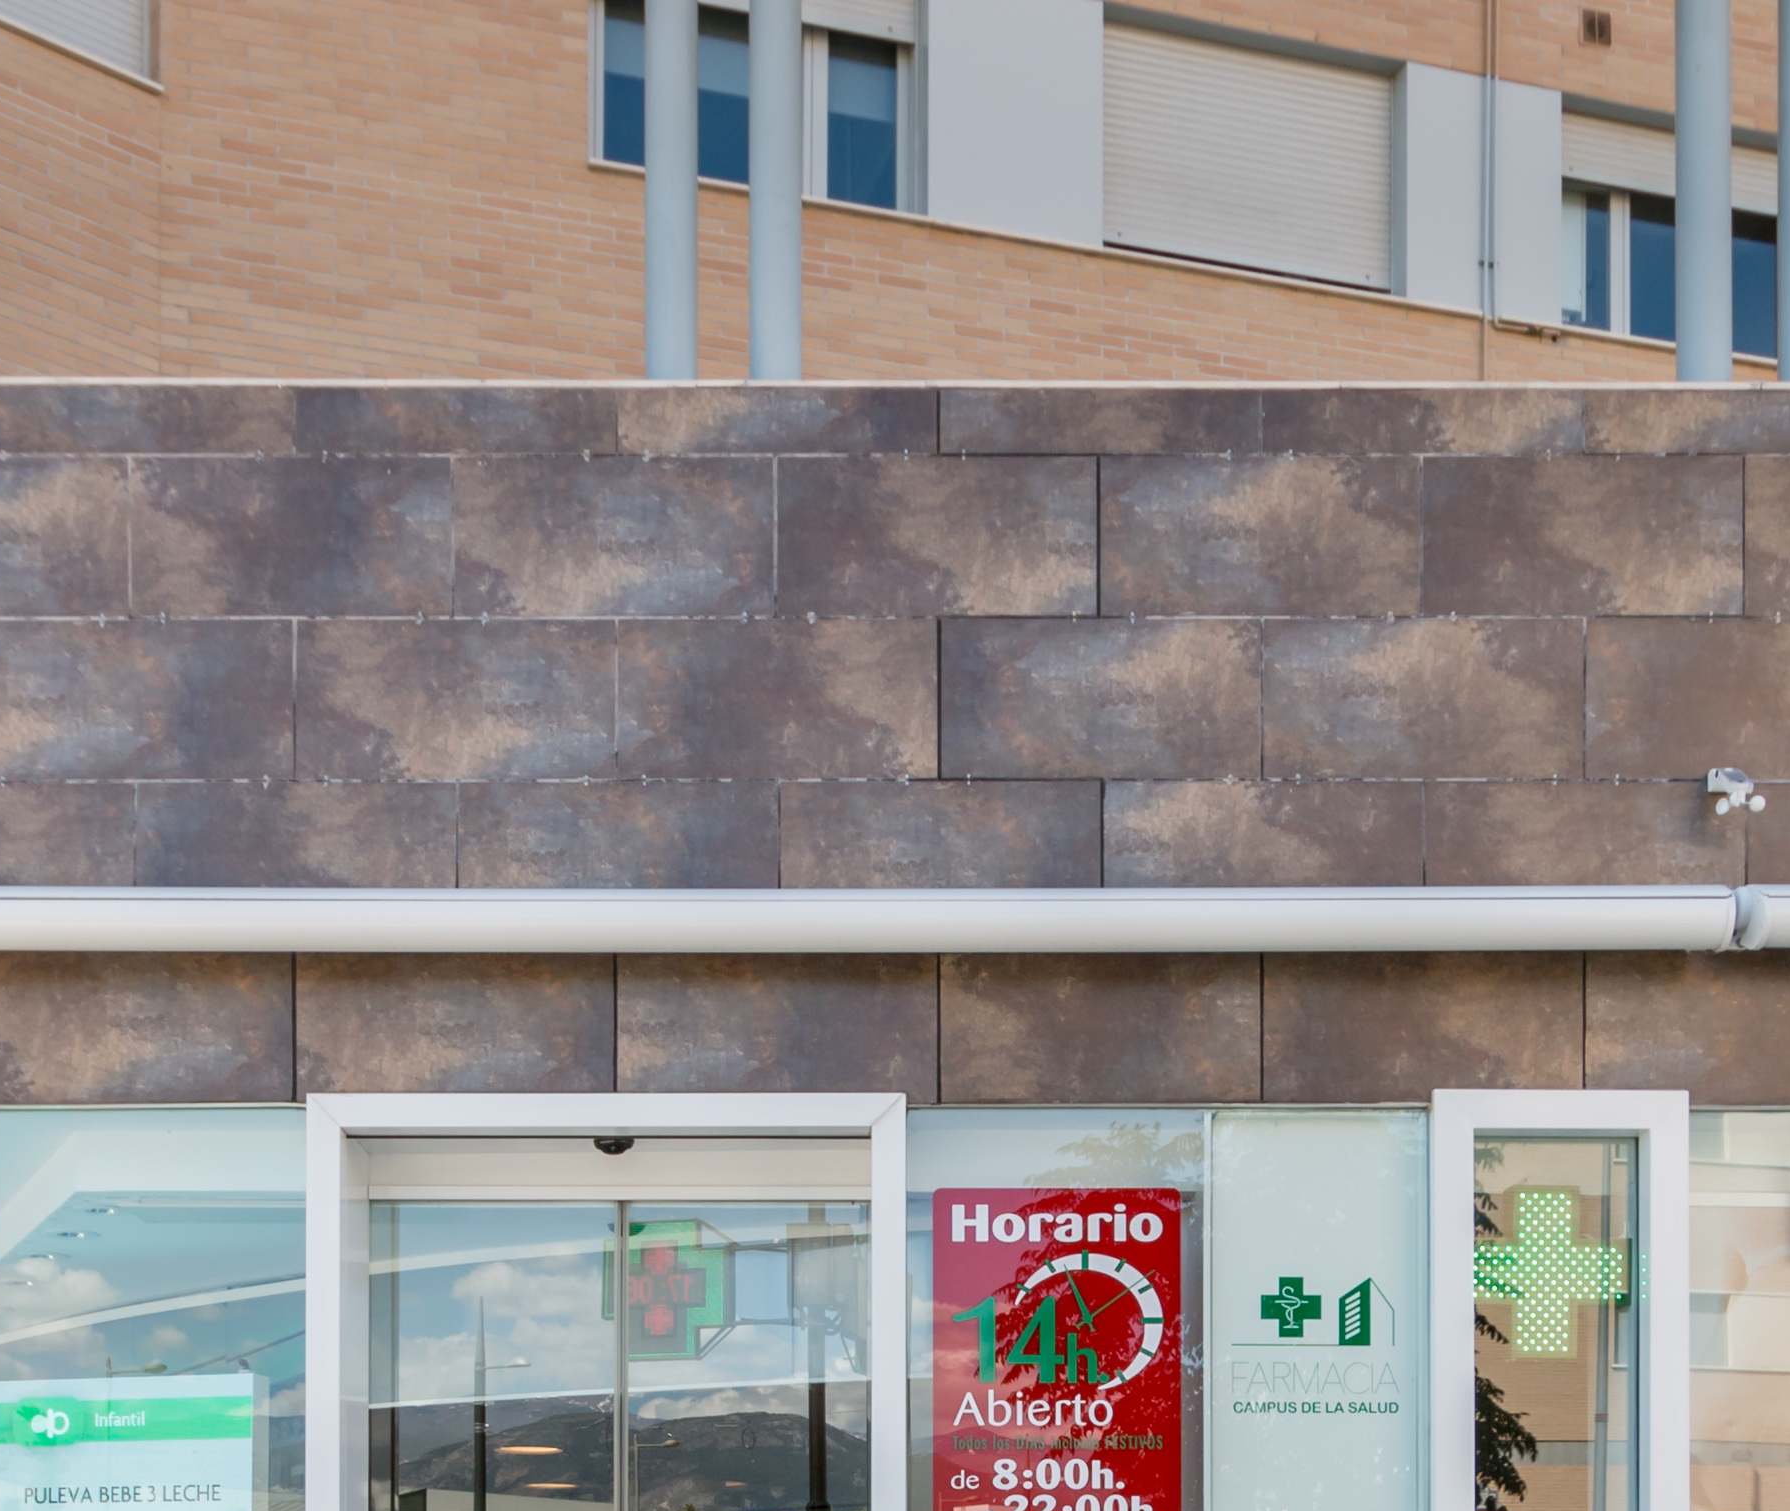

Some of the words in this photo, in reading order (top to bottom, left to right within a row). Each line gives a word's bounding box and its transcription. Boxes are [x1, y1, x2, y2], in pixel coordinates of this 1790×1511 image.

[952, 1203, 1163, 1243] Horario
[953, 1296, 1110, 1383] 14h.
[1231, 1361, 1400, 1395] FARMACIA
[95, 1411, 146, 1428] Infantil
[953, 1390, 1113, 1427] Abierto
[1233, 1401, 1297, 1414] CAMPUS
[1301, 1402, 1321, 1414] DE
[1325, 1402, 1344, 1414] LA
[1348, 1401, 1399, 1414] SALUD
[953, 1436, 987, 1449] Todos
[993, 1435, 1010, 1449] los
[1105, 1435, 1163, 1449] FESTIVOS
[951, 1469, 980, 1490] de
[992, 1459, 1125, 1490] 8:00h.
[24, 1487, 93, 1504] PULEVA
[100, 1486, 143, 1503] BEBE
[147, 1486, 156, 1502] 3
[163, 1485, 221, 1502] LECHE
